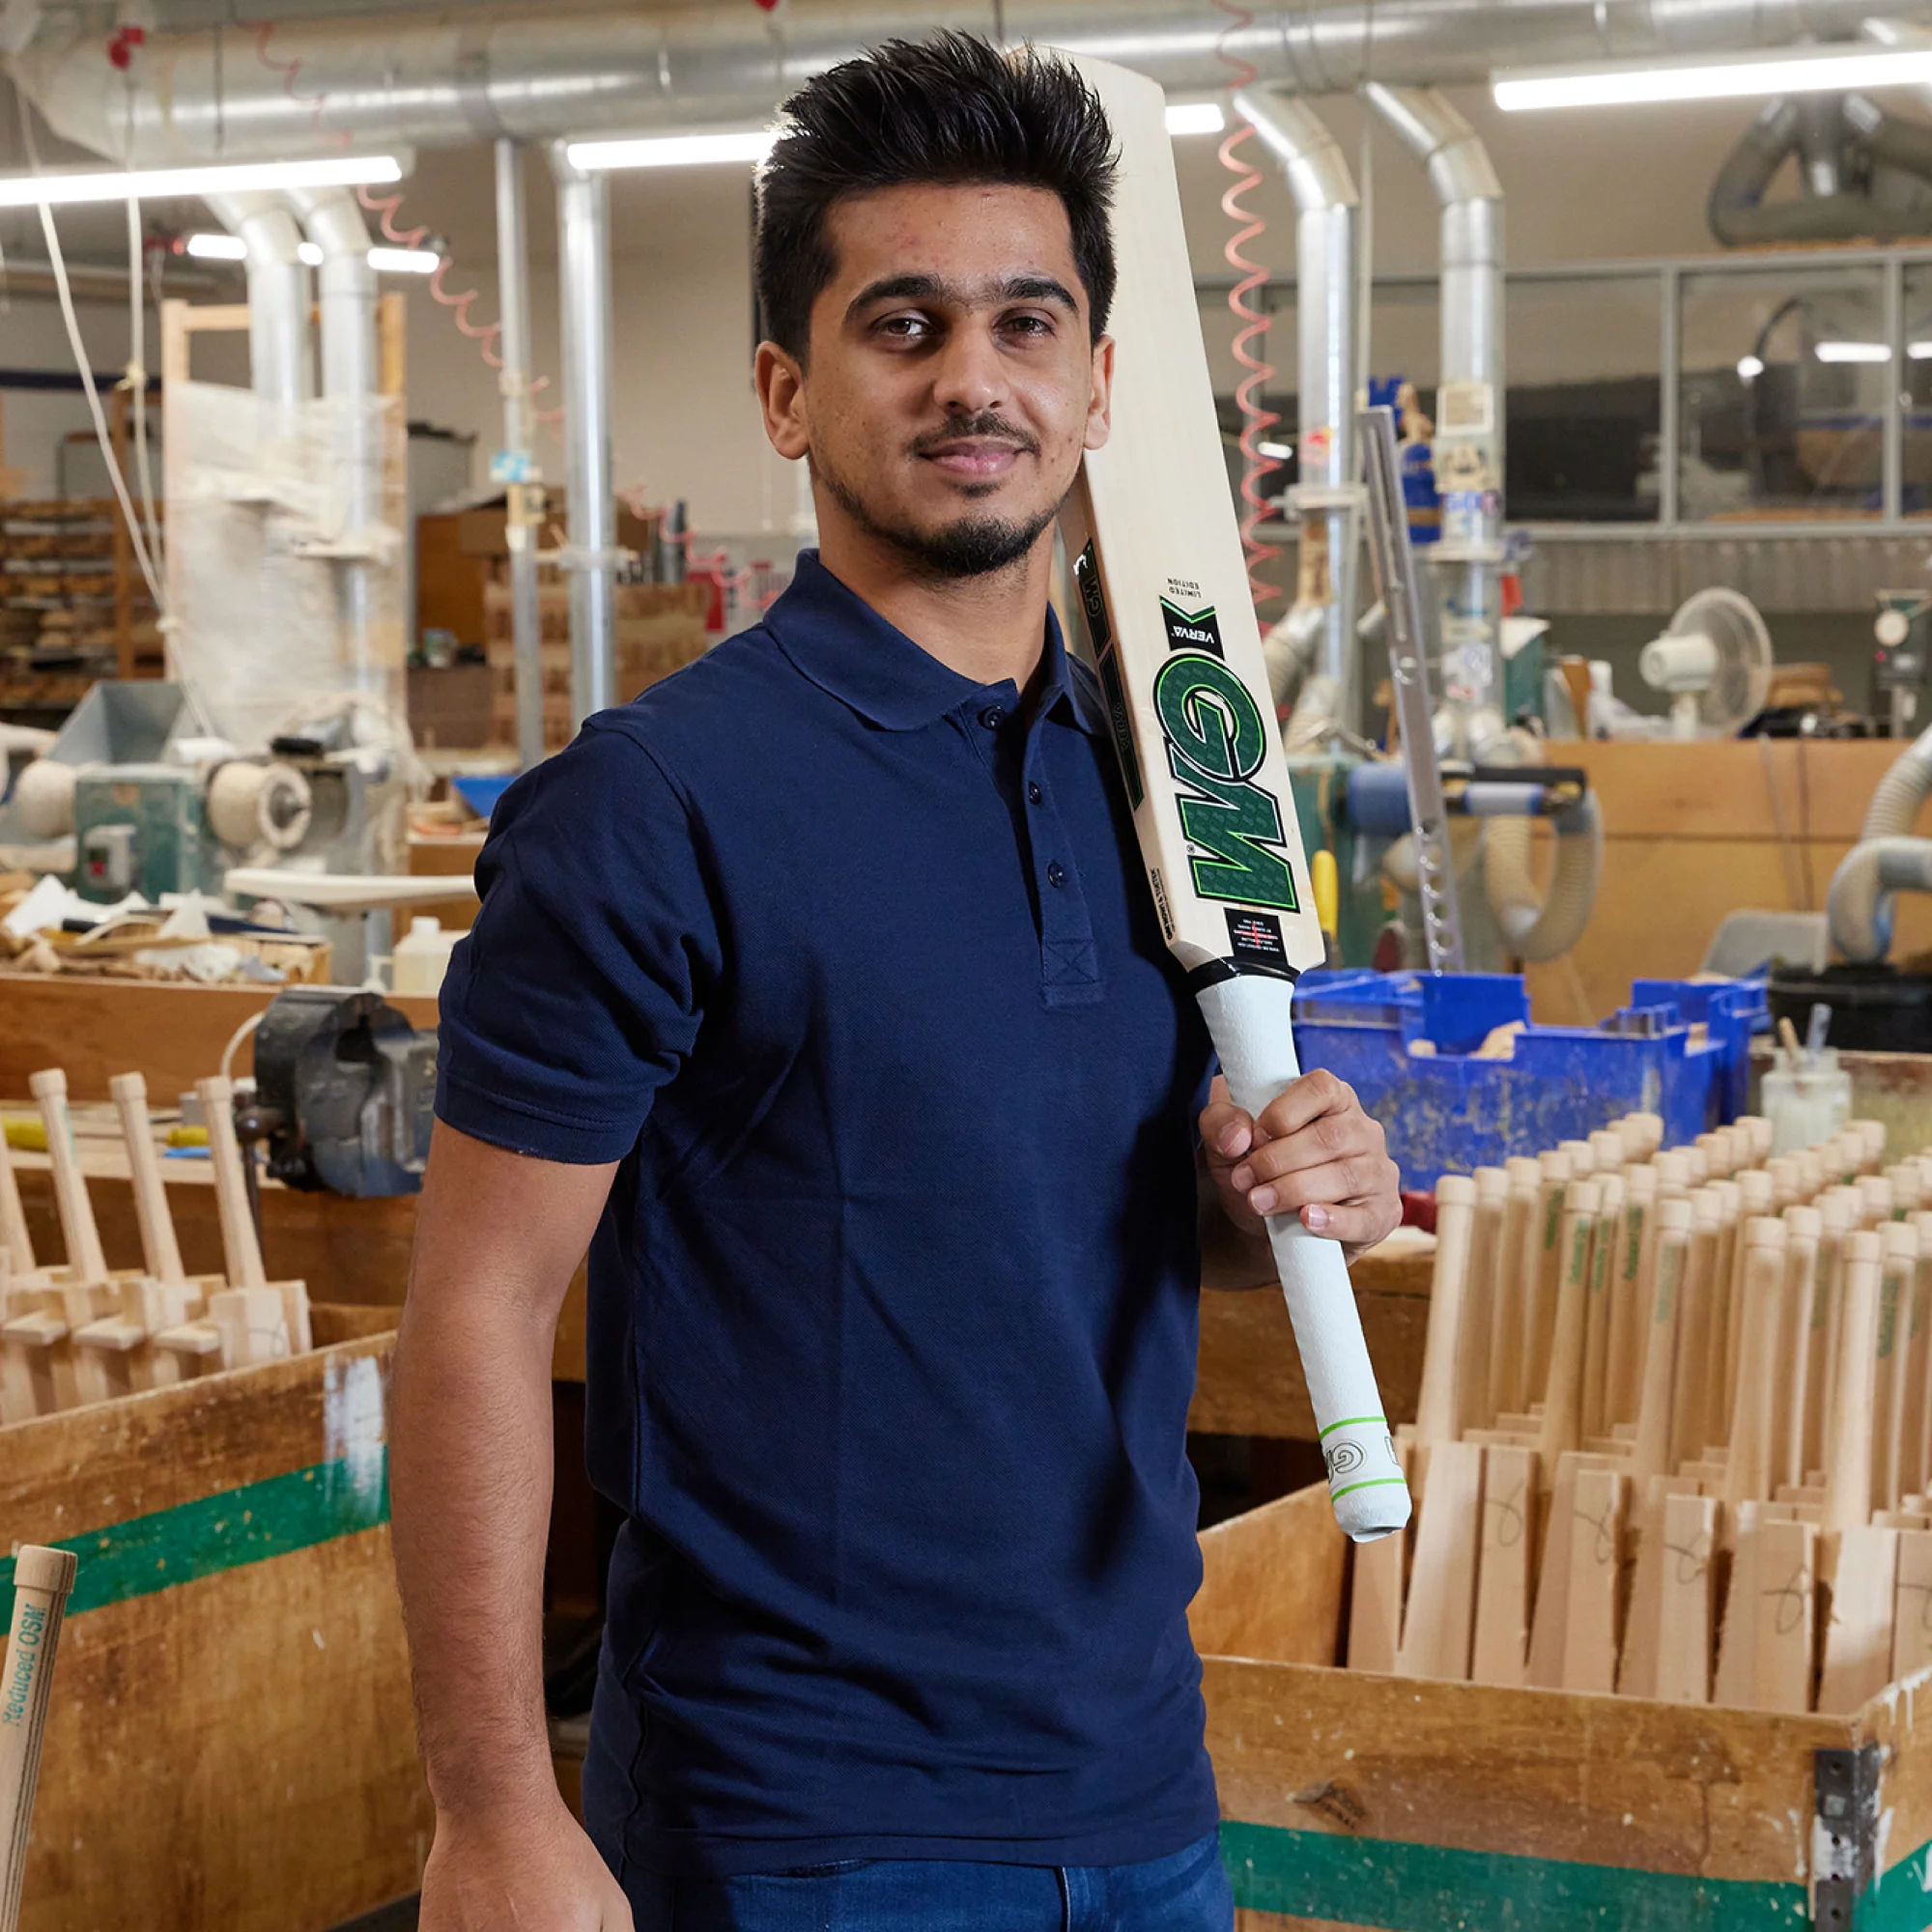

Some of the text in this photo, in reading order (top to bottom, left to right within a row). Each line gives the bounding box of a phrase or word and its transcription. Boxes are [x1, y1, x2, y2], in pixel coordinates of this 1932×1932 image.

[1173, 625, 1214, 644] VERVA
[1153, 653, 1300, 914] GM
[18, 1604, 46, 1646] OSM
